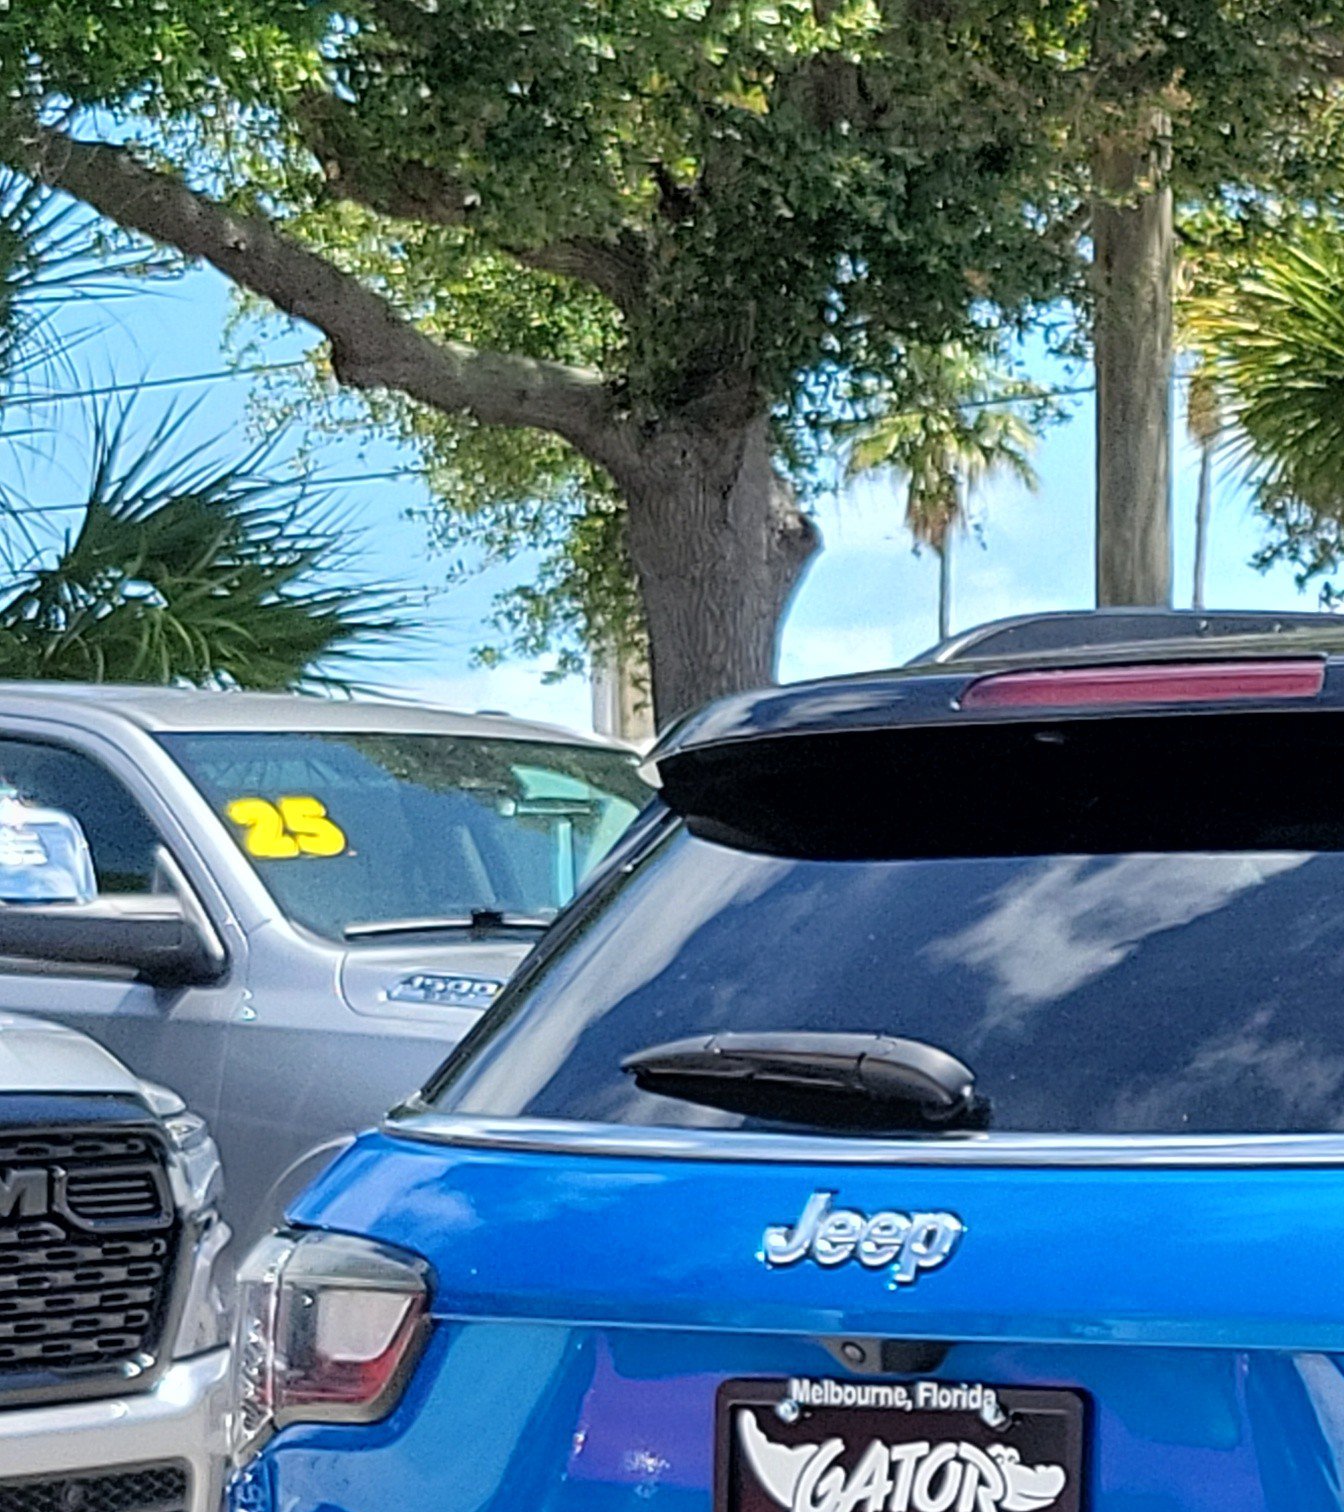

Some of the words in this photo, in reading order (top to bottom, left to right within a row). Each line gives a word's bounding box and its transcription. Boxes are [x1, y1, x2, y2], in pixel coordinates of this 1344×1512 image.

[227, 796, 347, 858] 25
[760, 1192, 964, 1283] Jeep
[790, 1378, 912, 1409] Melbourne,
[916, 1381, 997, 1411] Florida
